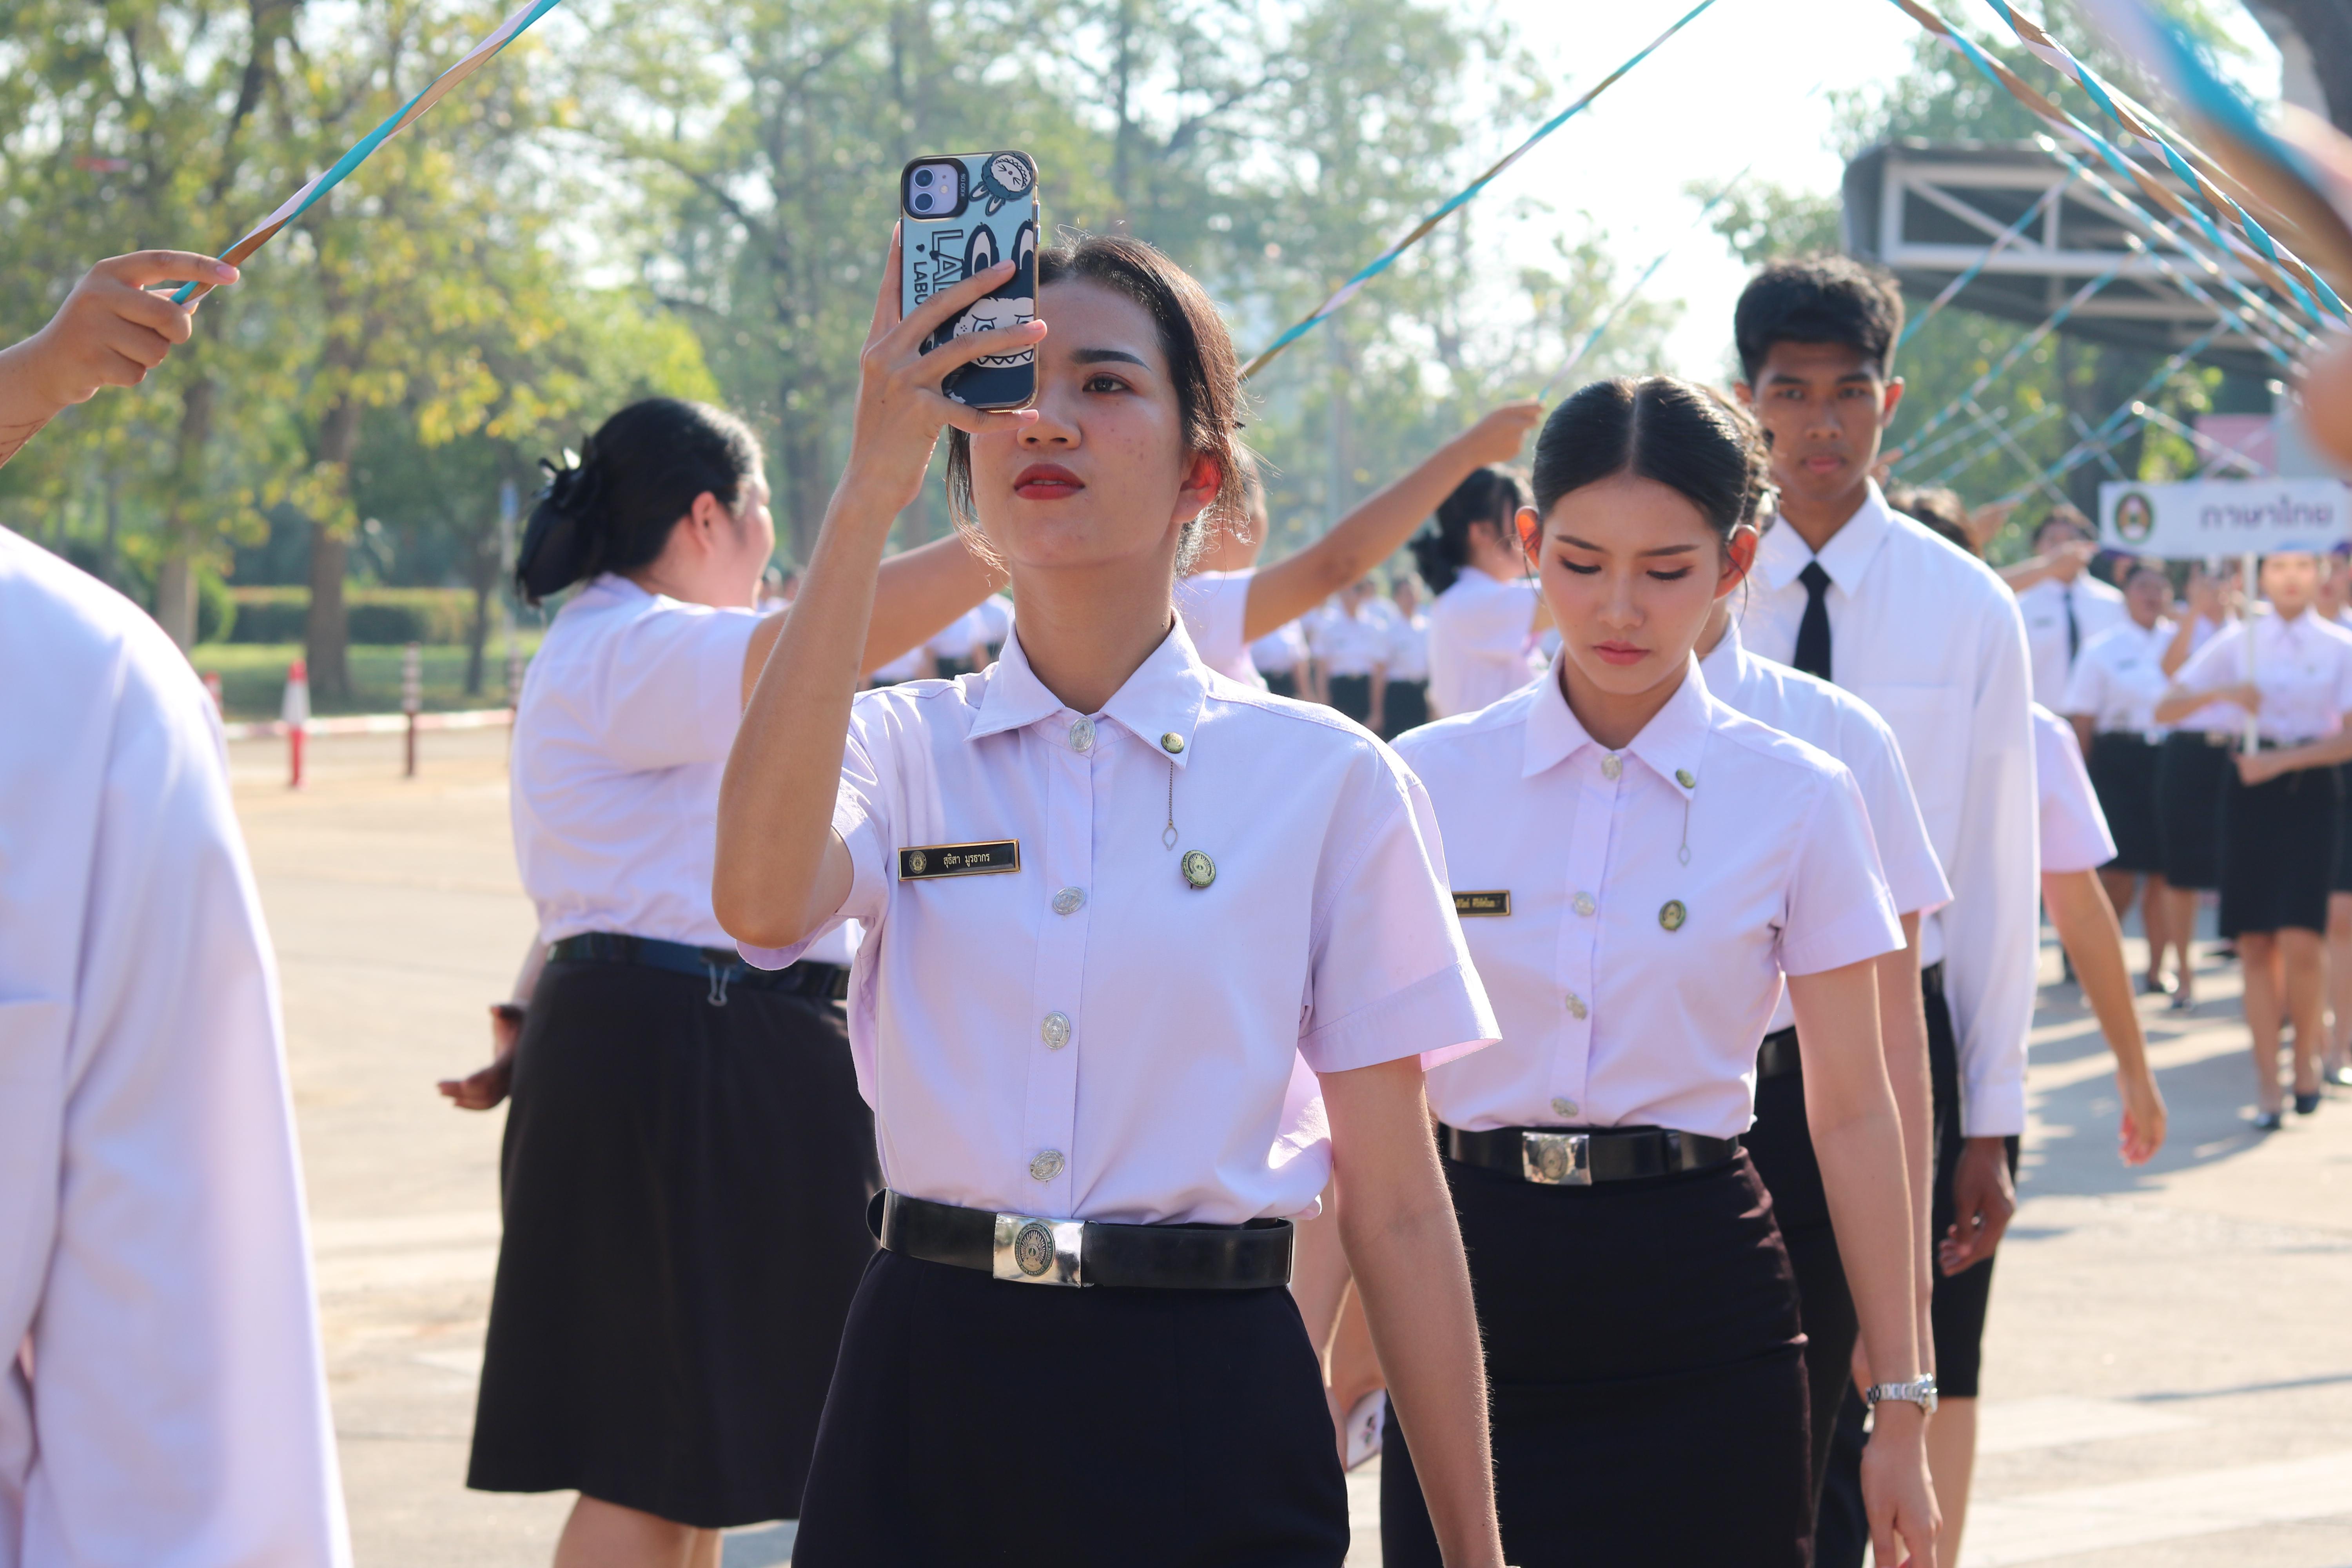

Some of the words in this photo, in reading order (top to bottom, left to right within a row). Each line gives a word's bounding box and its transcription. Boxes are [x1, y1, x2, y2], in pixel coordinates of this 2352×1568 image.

[2200, 494, 2333, 528] ภาษาไทย
[943, 853, 960, 868] สุธิสา
